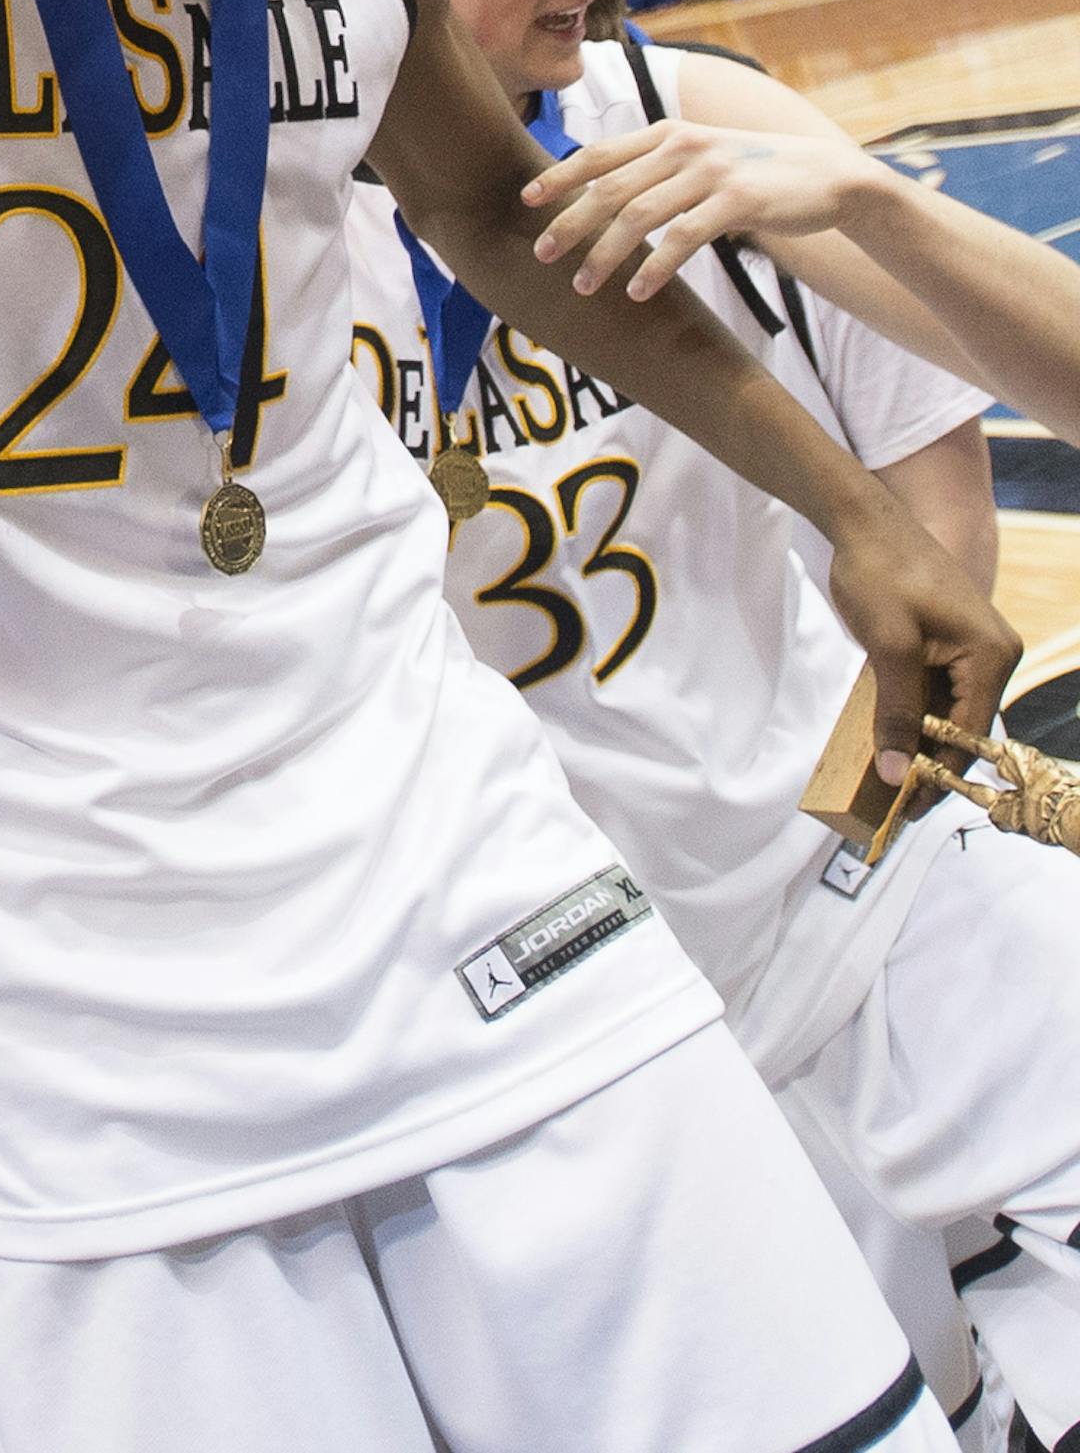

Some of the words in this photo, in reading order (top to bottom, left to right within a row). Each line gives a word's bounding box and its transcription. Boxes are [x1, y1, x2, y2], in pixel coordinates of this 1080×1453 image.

[447, 456, 658, 691] 33
[514, 888, 614, 965] JORDAN
[615, 876, 644, 904] XL
